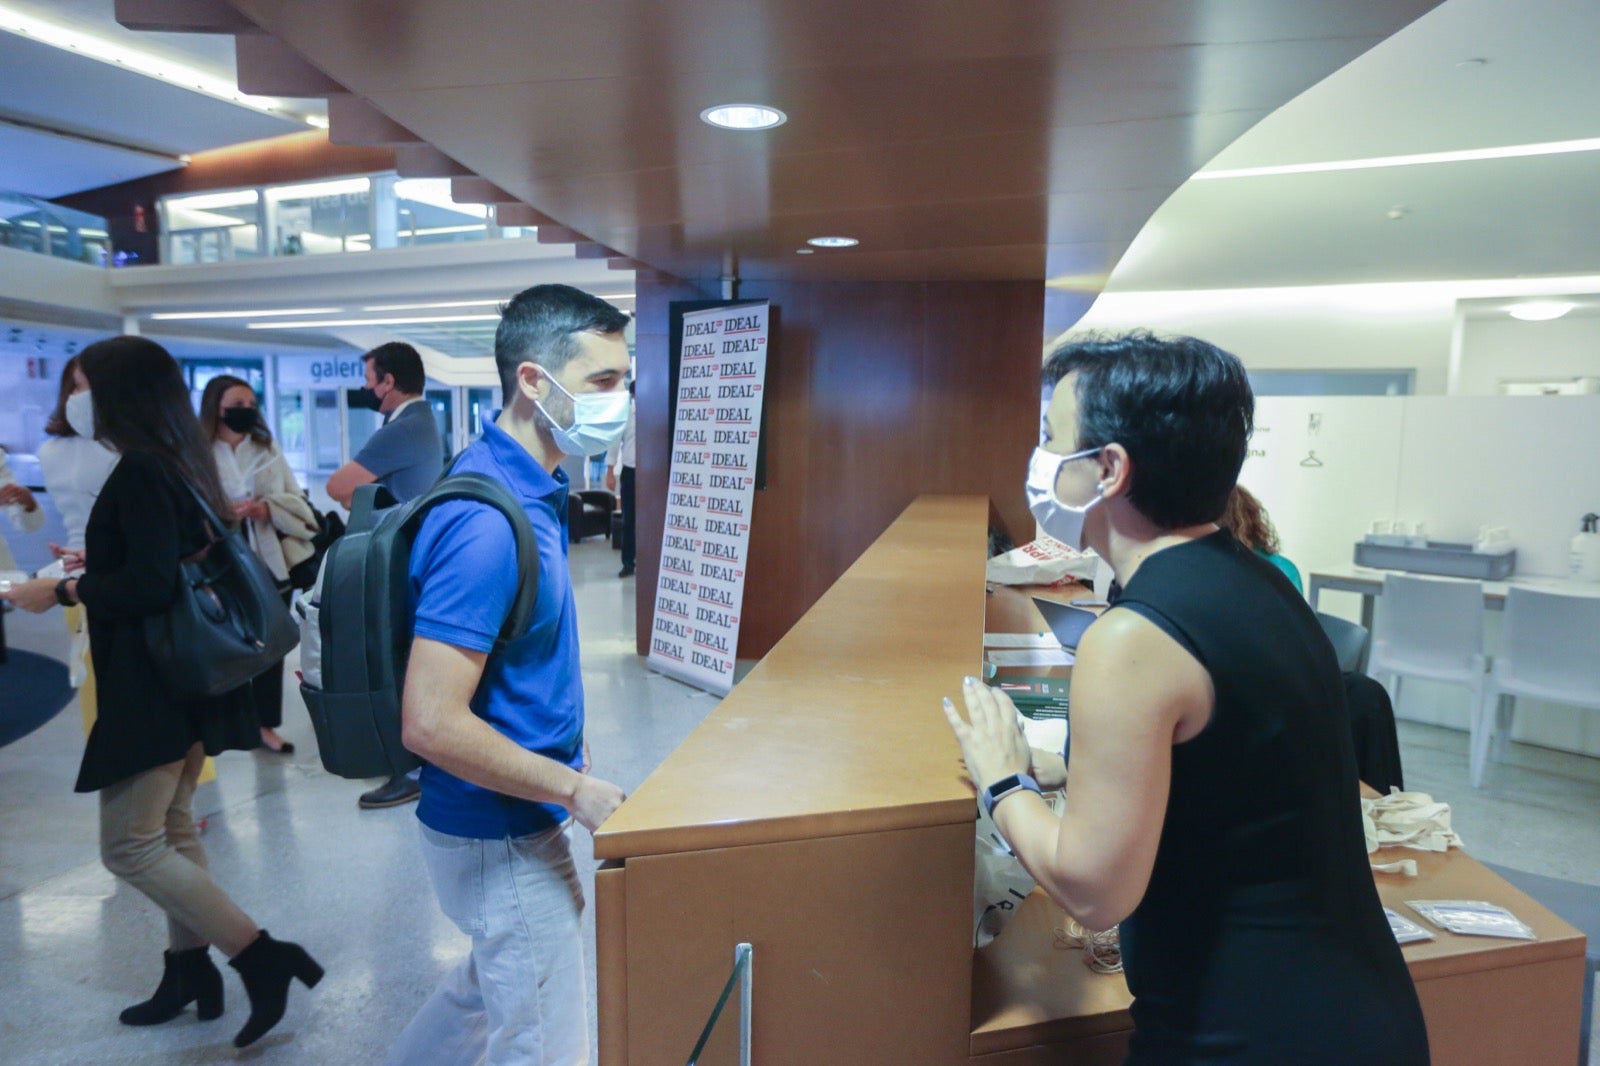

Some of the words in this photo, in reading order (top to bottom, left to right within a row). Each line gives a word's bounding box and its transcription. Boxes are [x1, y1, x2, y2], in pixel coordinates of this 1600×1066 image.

[685, 321, 717, 337] IDEAL
[724, 316, 760, 332] IDEAL
[684, 343, 715, 358] IDEAL
[722, 338, 758, 354] IDEAL
[682, 365, 713, 379] IDEAL
[720, 362, 756, 376] IDEAL
[680, 386, 711, 400] IDEAL
[718, 385, 754, 398] IDEAL
[678, 408, 709, 420] IDEAL
[716, 408, 752, 421] IDEAL
[676, 430, 707, 442] IDEAL
[714, 430, 750, 444] IDEAL
[674, 451, 704, 464] IDEAL
[711, 453, 748, 468] IDEAL
[672, 472, 702, 486] IDEAL
[709, 475, 745, 490] IDEAL
[670, 493, 700, 508] IDEAL
[707, 497, 743, 514] IDEAL
[667, 514, 698, 530] IDEAL
[704, 519, 741, 536] IDEAL
[665, 534, 696, 552] IDEAL
[702, 542, 738, 560] IDEAL
[662, 556, 694, 573] IDEAL
[700, 563, 736, 582] IDEAL
[660, 577, 691, 595] IDEAL
[698, 585, 734, 606] IDEAL
[658, 597, 689, 616] IDEAL
[696, 607, 731, 628] IDEAL
[655, 618, 687, 638] IDEAL
[694, 629, 728, 652] IDEAL
[653, 638, 684, 659] IDEAL
[691, 651, 726, 674] IDEAL
